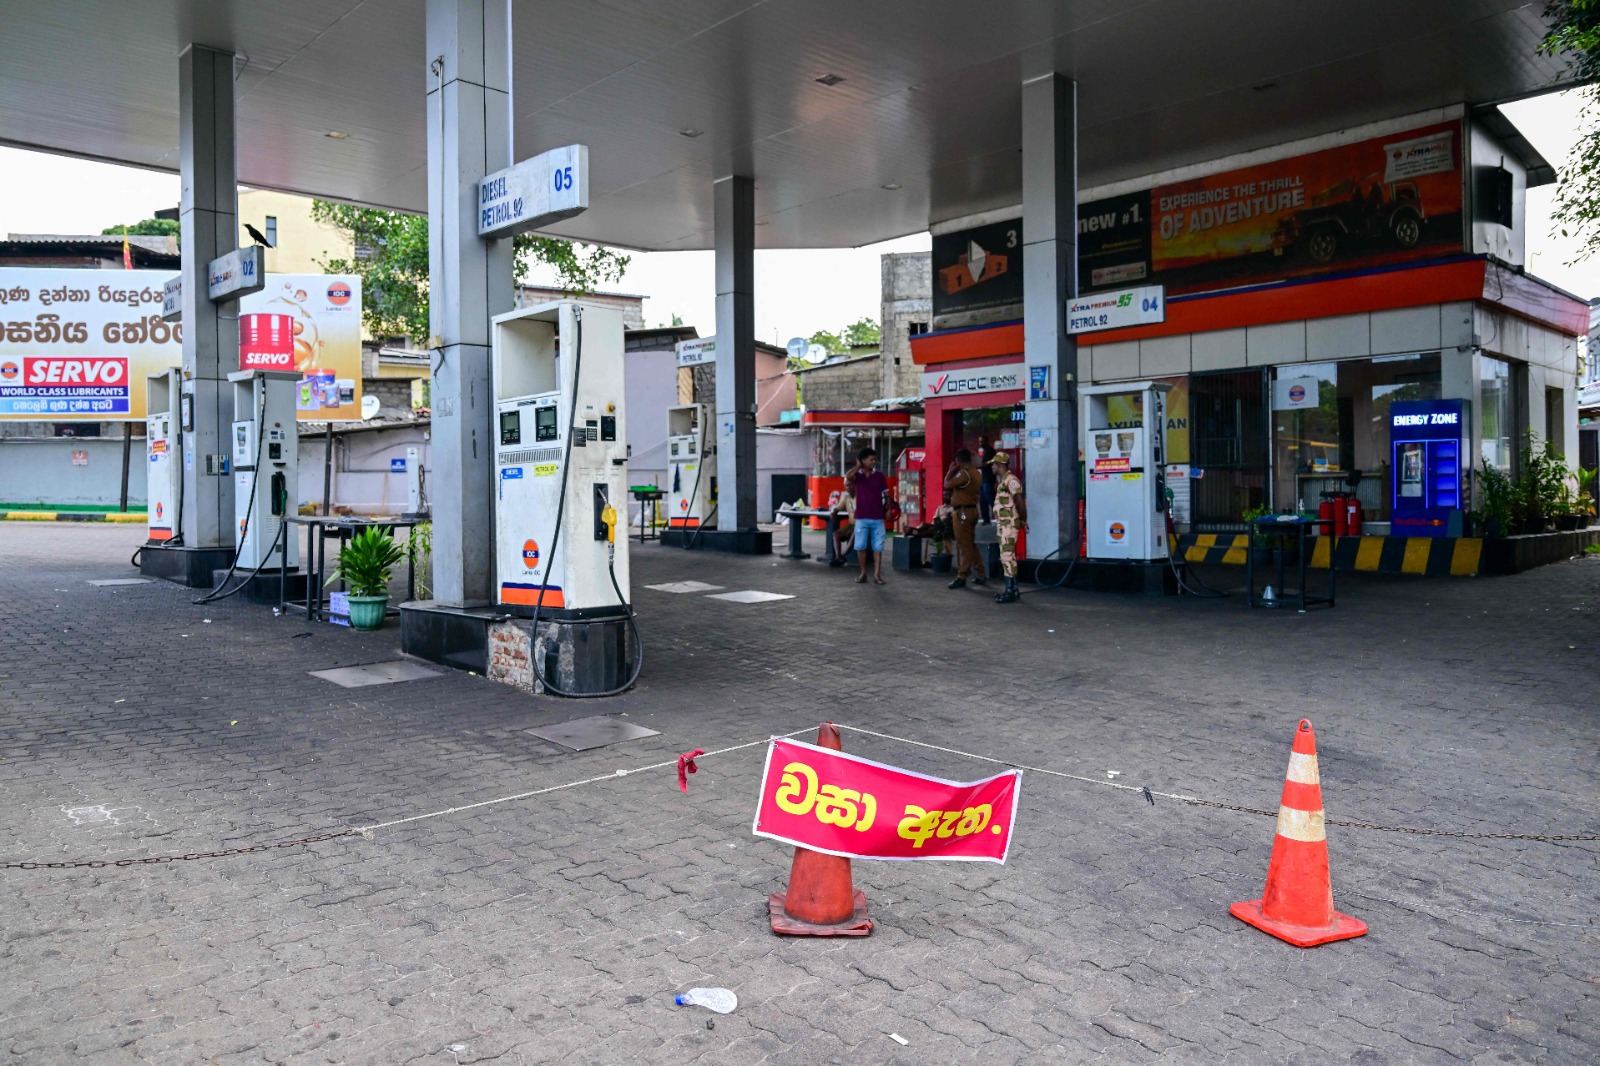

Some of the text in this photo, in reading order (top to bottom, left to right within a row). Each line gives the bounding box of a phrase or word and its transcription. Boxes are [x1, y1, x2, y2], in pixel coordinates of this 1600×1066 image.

[555, 167, 572, 191] 05
[482, 177, 508, 204] DIESEL
[1160, 176, 1304, 212] EXPERIENCE THE THRILL
[482, 197, 523, 229] PETROL 92
[1078, 212, 1117, 234] new
[1160, 189, 1305, 240] OF ADVENTURE
[1006, 229, 1018, 248] 3
[242, 261, 254, 275] 02
[39, 285, 91, 306] දන්නා
[1116, 293, 1133, 308] 95
[1142, 296, 1158, 312] 04
[0, 313, 89, 344] සනීය
[1070, 314, 1108, 330] PETROL 92
[245, 352, 290, 364] SERVO
[29, 360, 123, 383] SERVO
[990, 375, 1017, 385] BANK
[1, 387, 124, 396] WORLD CLASS LUBRICANTS
[1393, 412, 1458, 427] ENERGY ZONE
[775, 762, 1002, 848] වසා ඇත.
